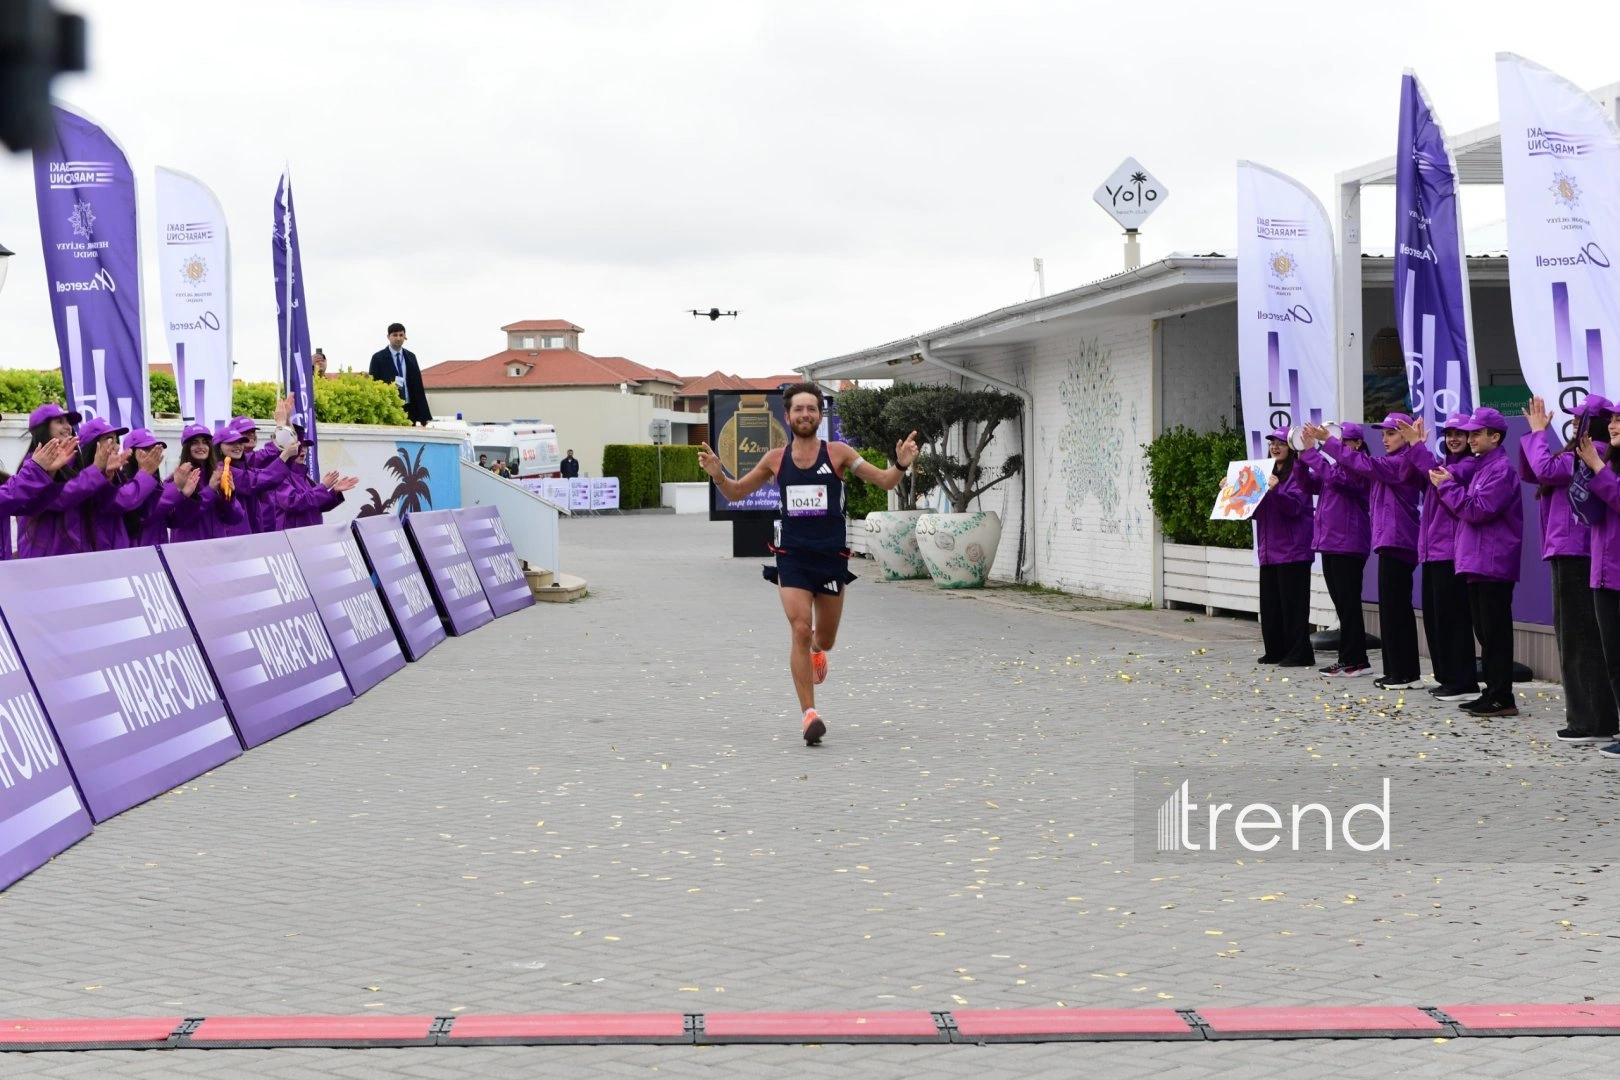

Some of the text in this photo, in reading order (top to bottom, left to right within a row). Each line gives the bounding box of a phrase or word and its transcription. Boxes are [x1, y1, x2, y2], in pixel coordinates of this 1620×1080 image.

[1105, 171, 1157, 207] Yolo
[792, 497, 821, 508] 10412
[131, 571, 188, 635] BAKI
[266, 552, 312, 604] BAKI
[250, 611, 334, 681] MARAFONU
[105, 643, 217, 731] MARAFONU
